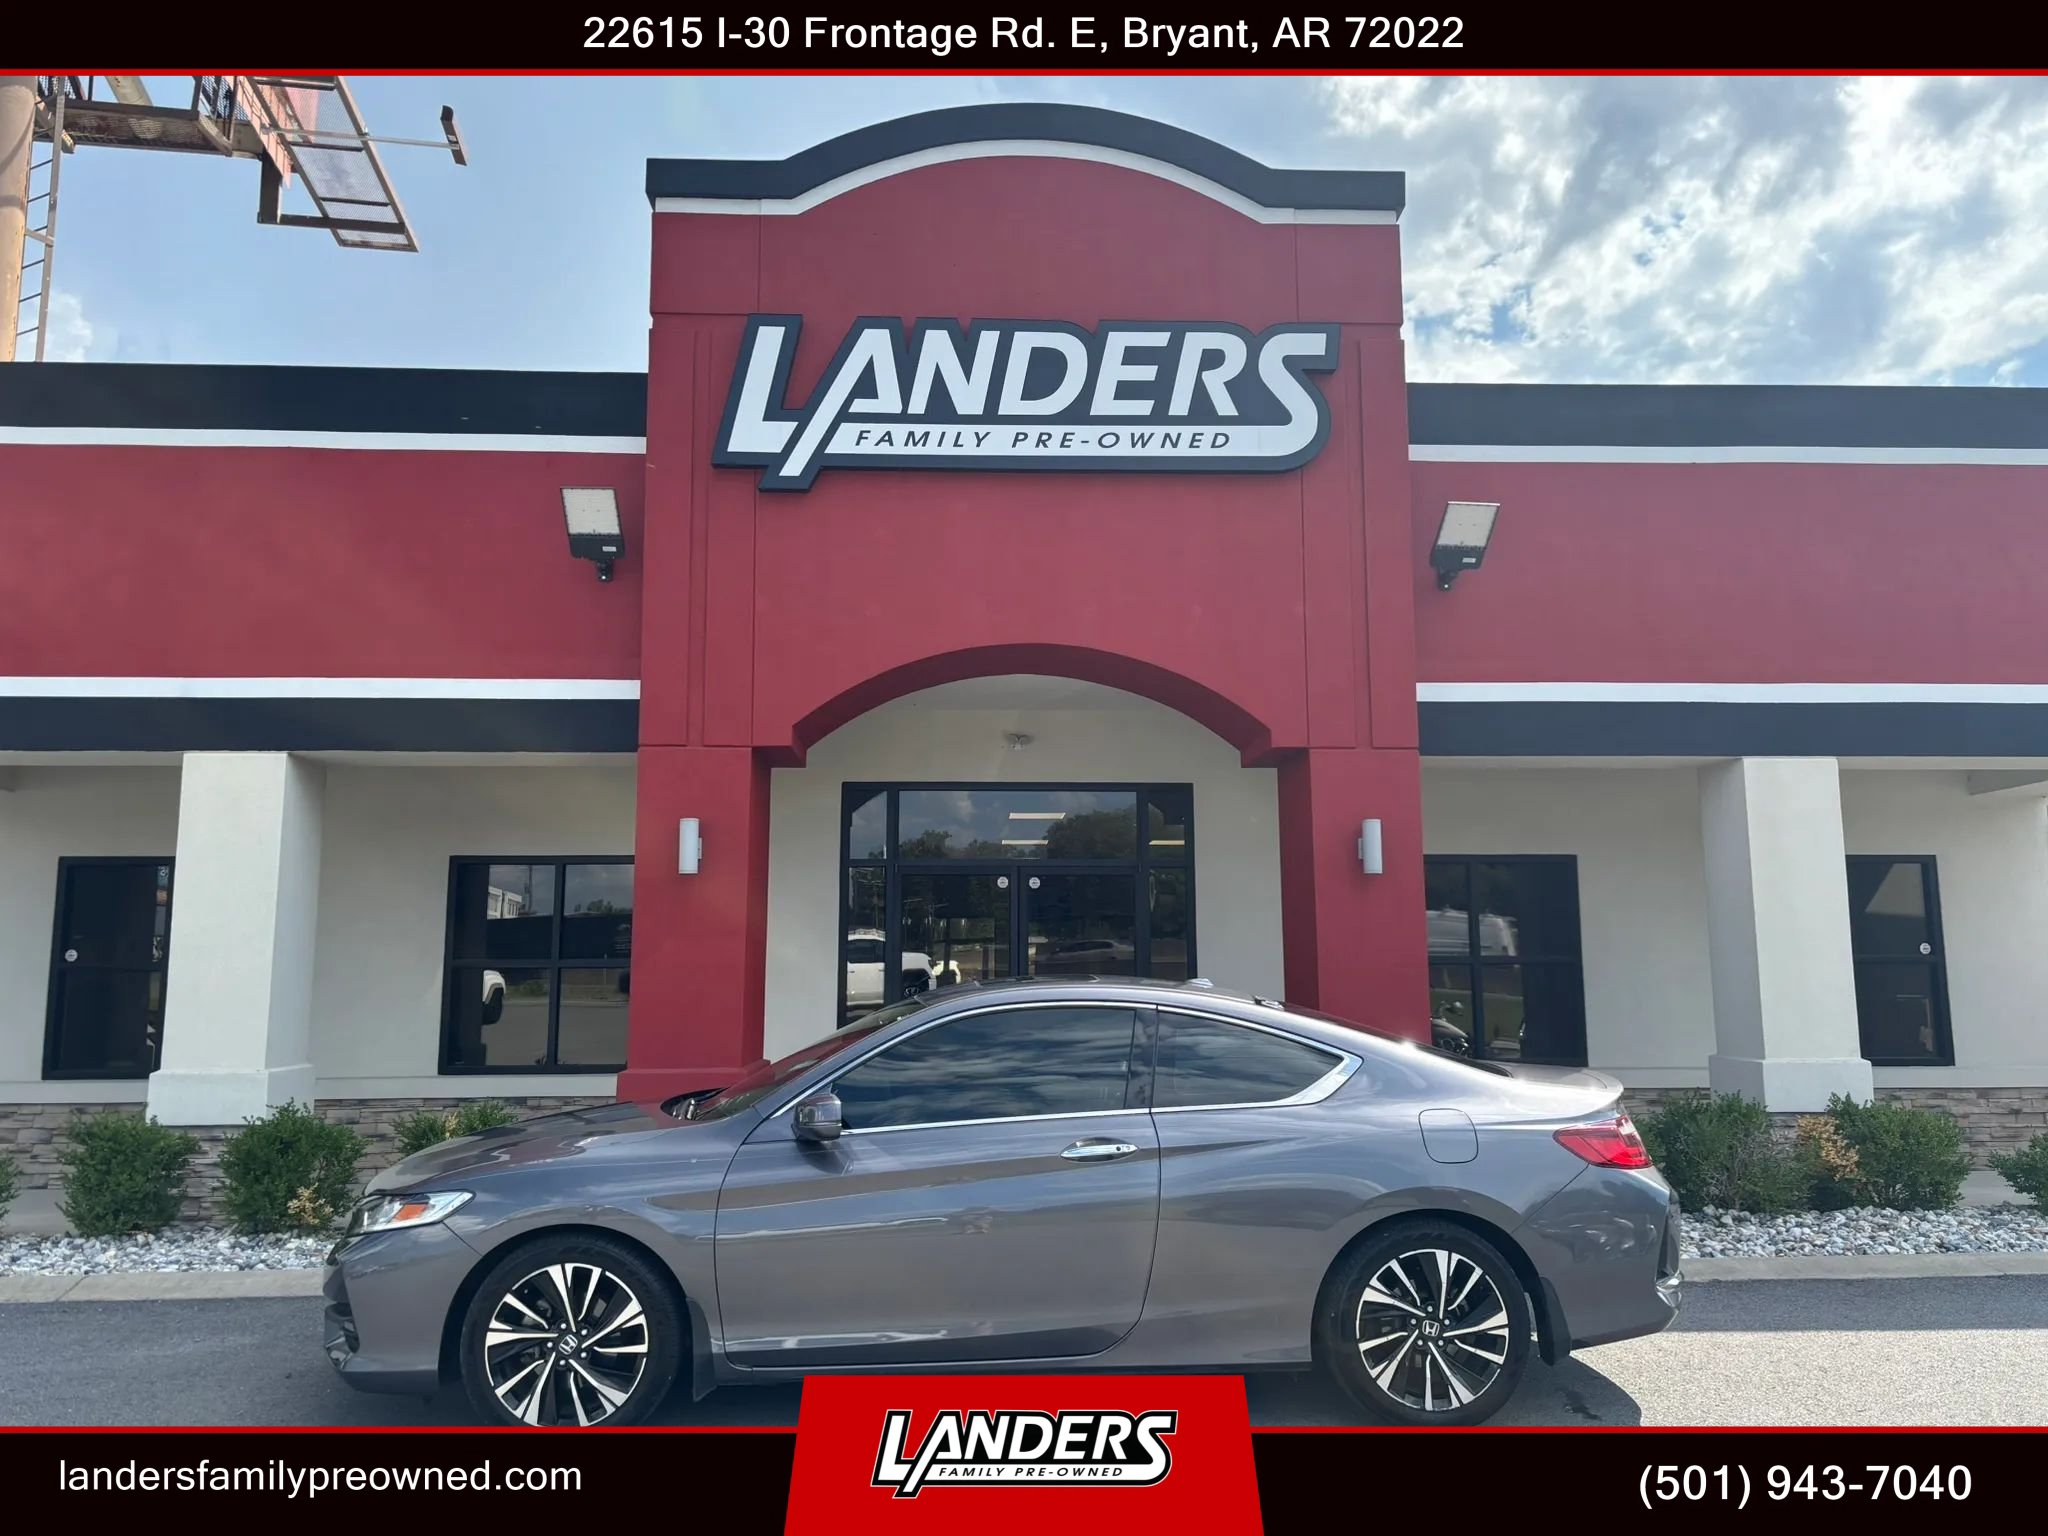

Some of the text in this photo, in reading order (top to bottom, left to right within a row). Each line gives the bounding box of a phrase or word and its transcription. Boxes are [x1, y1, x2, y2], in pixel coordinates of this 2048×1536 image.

[727, 325, 1328, 476] LANDERS
[855, 429, 1232, 450] FAMILY PRE-OWNED
